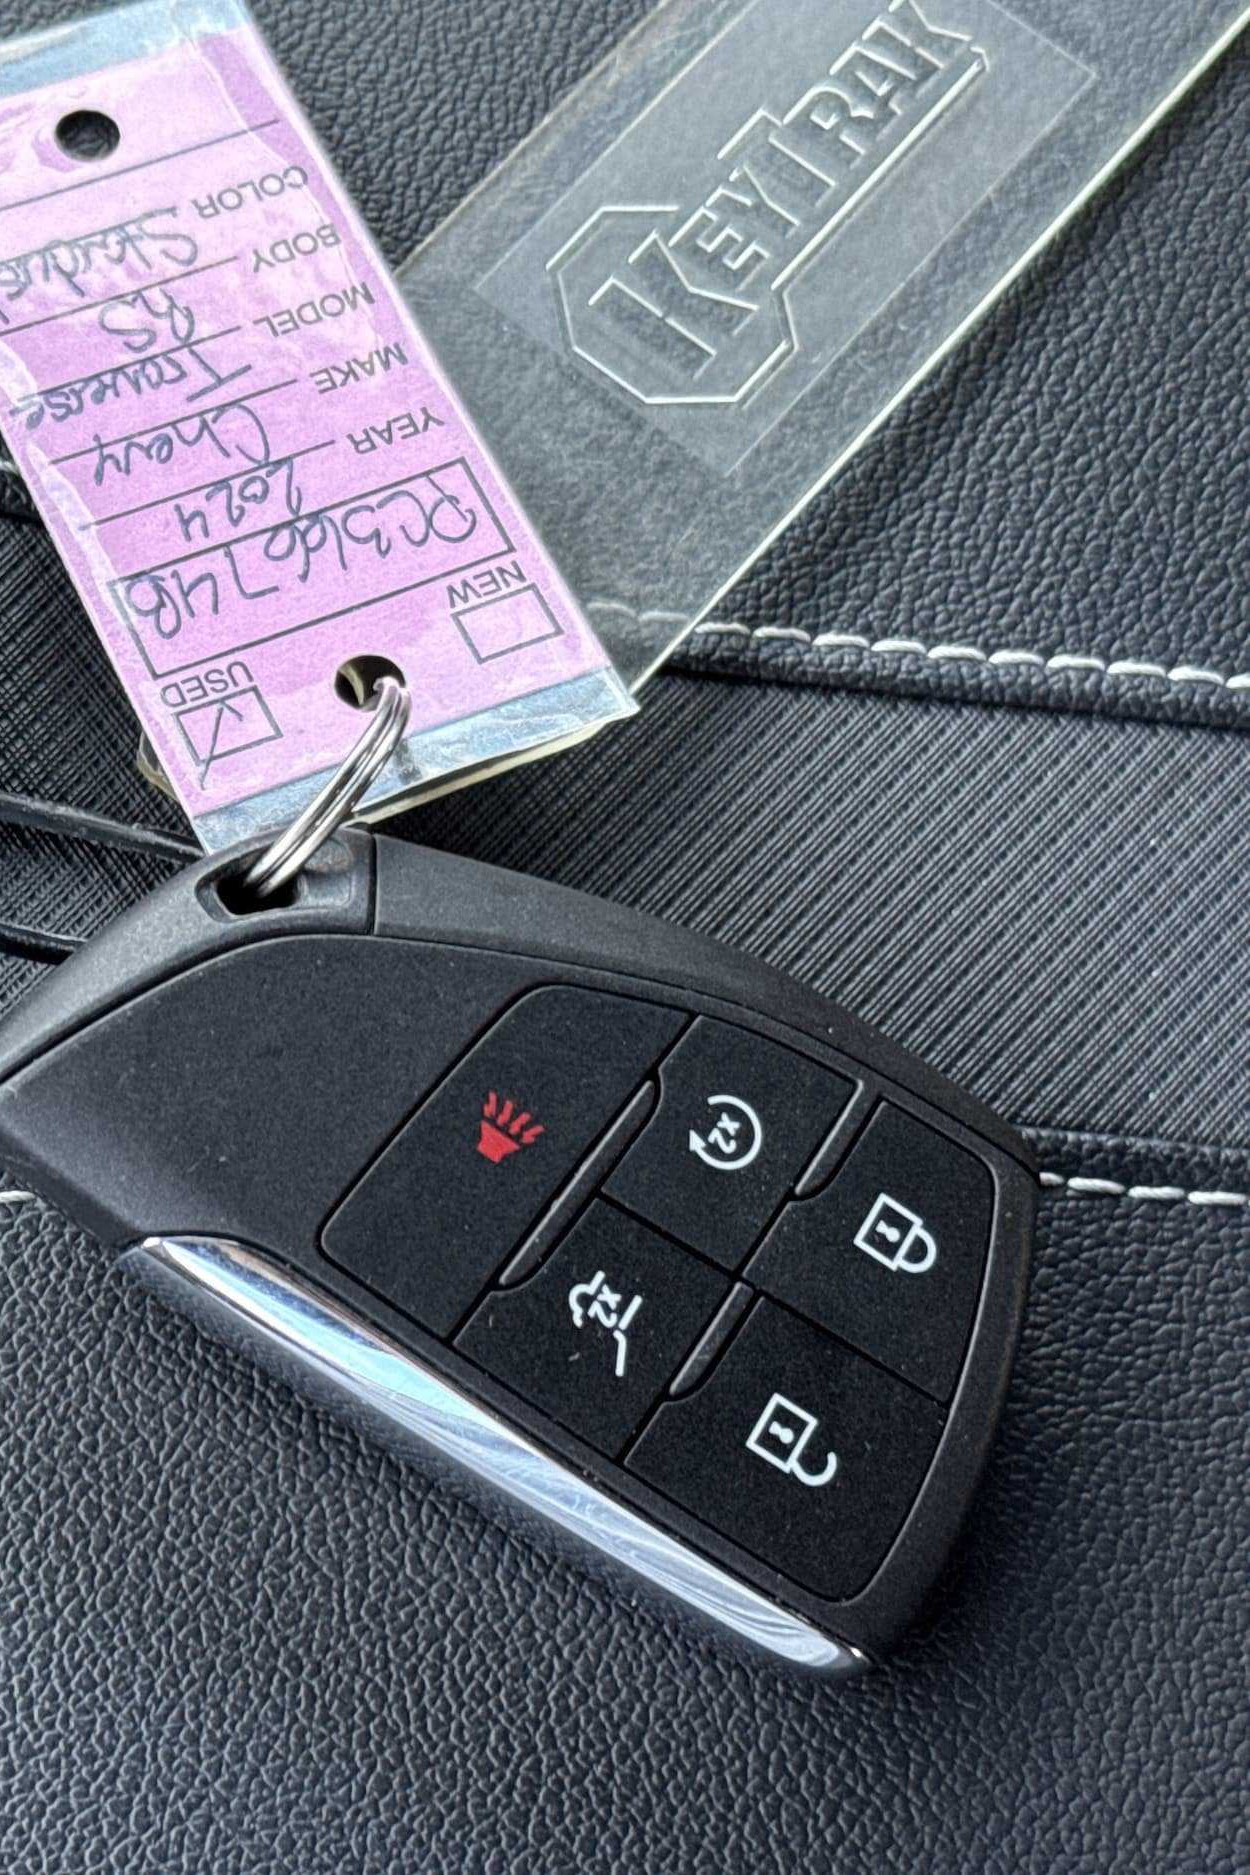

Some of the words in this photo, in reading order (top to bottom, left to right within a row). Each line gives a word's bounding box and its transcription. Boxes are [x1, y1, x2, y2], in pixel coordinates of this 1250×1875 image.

[194, 164, 309, 219] COLOR
[251, 223, 342, 273] BODY
[98, 288, 196, 353] RS
[253, 281, 377, 340] MODEL
[9, 344, 252, 430] Traverse
[314, 342, 409, 396] MAKE
[93, 402, 270, 486] Chevy
[350, 405, 445, 455] YEAR
[174, 457, 302, 542] 2024
[447, 561, 527, 609] NEW
[160, 660, 253, 707] USED
